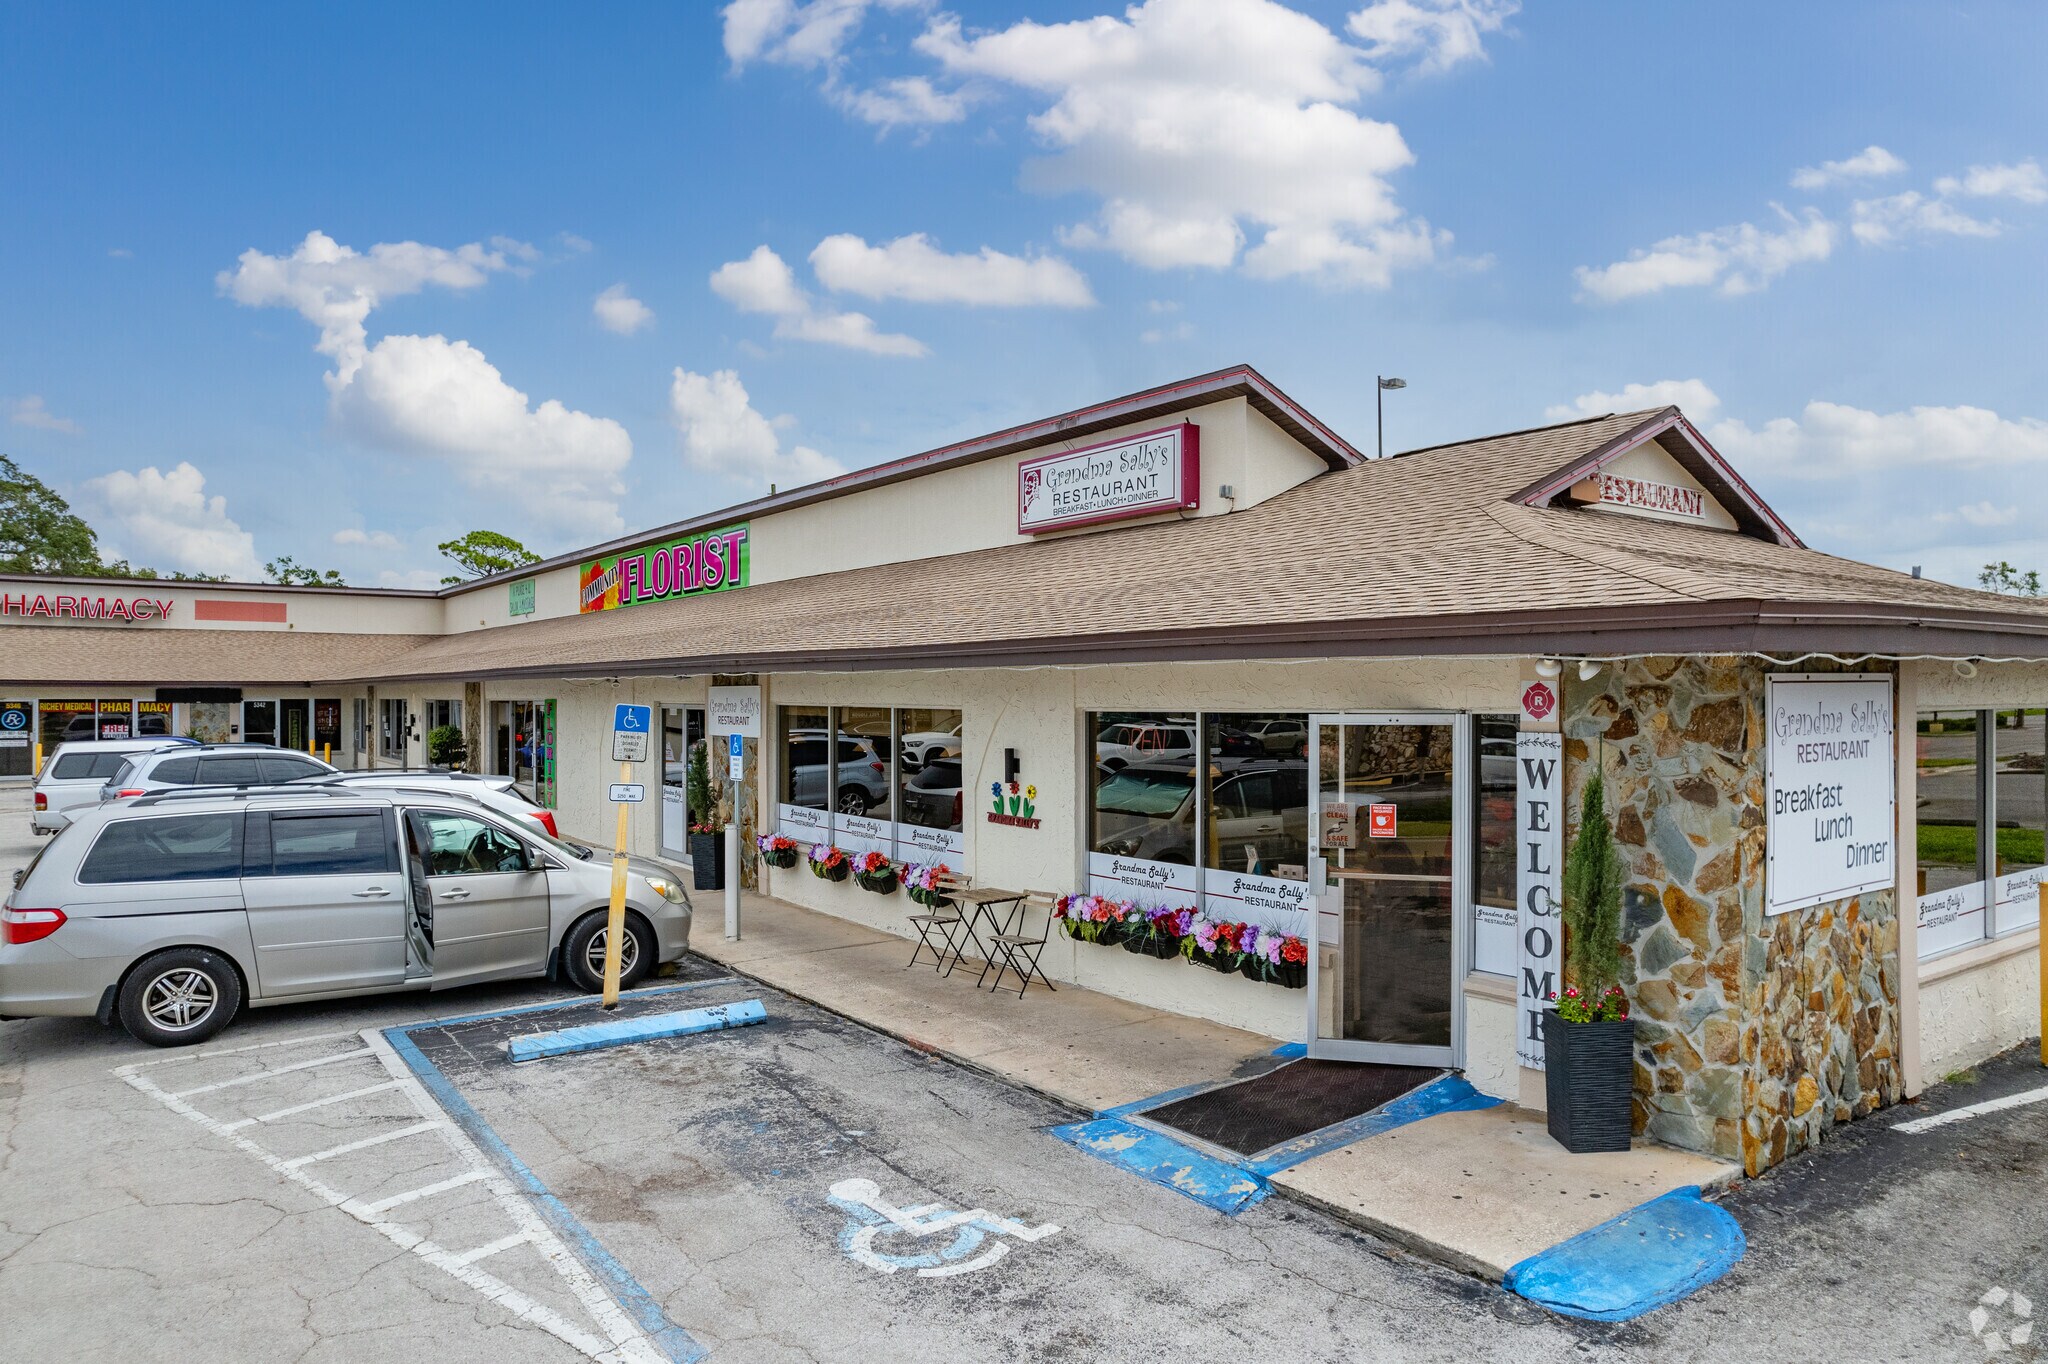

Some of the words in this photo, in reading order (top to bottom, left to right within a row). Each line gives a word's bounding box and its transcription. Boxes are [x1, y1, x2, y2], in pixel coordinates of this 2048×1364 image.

[1046, 457, 1113, 492] Grandma
[1120, 444, 1168, 473] Sally's
[1052, 473, 1158, 506] RESTAURANT
[581, 564, 619, 606] COMMUNITY
[622, 528, 748, 604] FLORIST
[0, 593, 174, 620] HARMACY
[40, 702, 64, 711] RICHEY
[65, 702, 93, 711] MEDICAL
[100, 702, 131, 712] PHAR
[140, 702, 171, 712] MACY
[710, 697, 737, 716] Grandma
[740, 697, 760, 716] Sally's
[1534, 695, 1544, 706] R
[102, 724, 128, 733] FREE
[718, 715, 750, 725] RESTAURANT
[1775, 701, 1843, 746] Grandma
[1851, 700, 1888, 738] Sally's
[1117, 727, 1166, 755] OPEN
[546, 702, 554, 805] FLORIST
[1797, 739, 1870, 764] RESTAURANT
[1775, 782, 1843, 815] Breakfast
[790, 808, 807, 820] Grandma
[794, 819, 816, 828] RESTAURANT
[846, 818, 866, 830] Grandma
[867, 821, 882, 834] Sally's
[1815, 812, 1853, 843] Lunch
[851, 829, 876, 840] RESTAURANT
[912, 829, 935, 841] Grandma
[936, 832, 954, 846] Sally's
[918, 841, 947, 853] RESTAURANT
[1846, 841, 1888, 869] Dinner
[1112, 860, 1147, 874] Grandma
[1148, 864, 1175, 882] Sally's
[1121, 876, 1164, 890] RESTAURANT
[1233, 878, 1276, 894] Grandma
[1279, 884, 1309, 903] Sally'
[1244, 896, 1298, 912] RESTAURANT
[1521, 757, 1557, 1043] WELCOME
[1477, 909, 1503, 918] Grandma
[1920, 900, 1946, 920] Grandma
[1484, 918, 1516, 927] RESTAURANT
[1927, 912, 1958, 929] RESTAURANT
